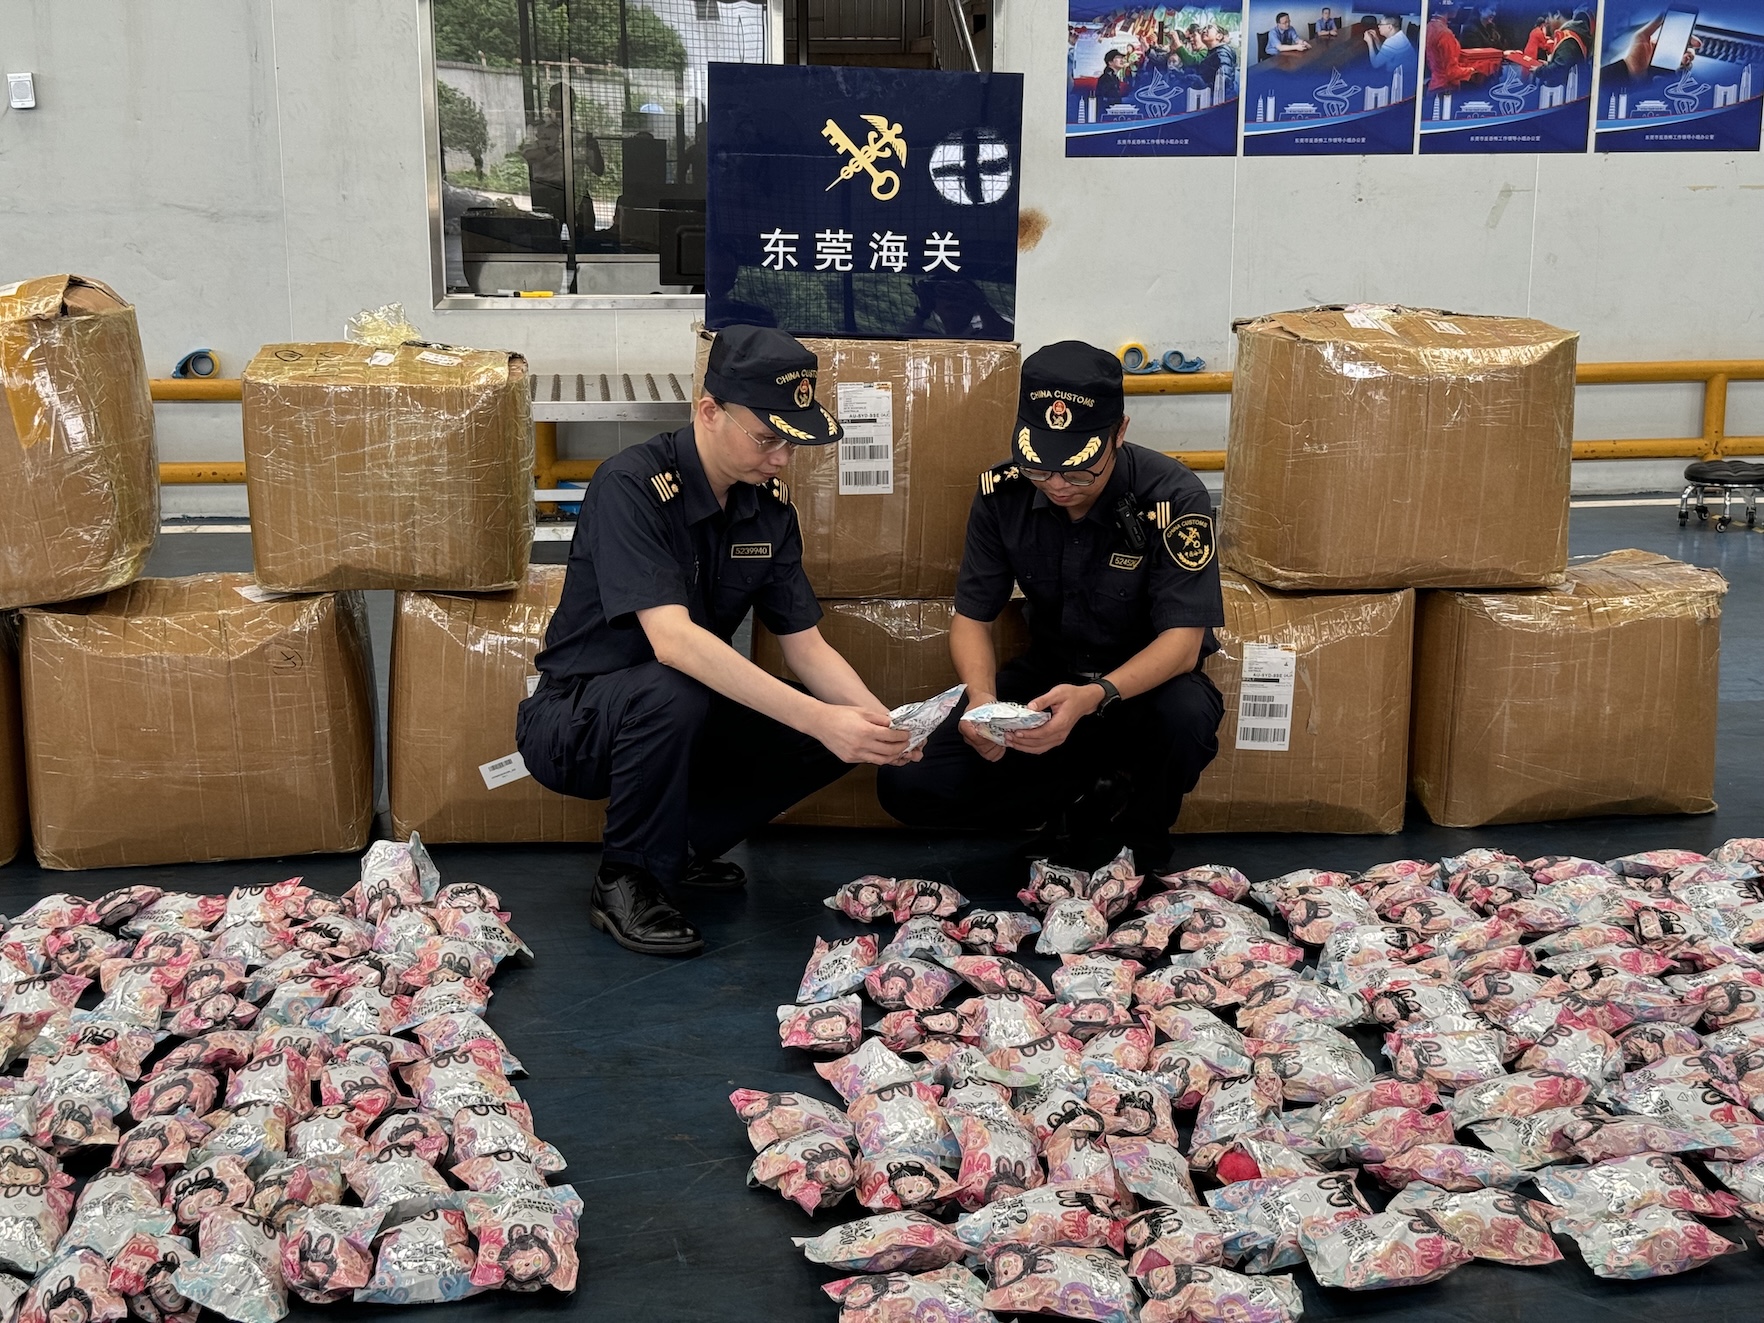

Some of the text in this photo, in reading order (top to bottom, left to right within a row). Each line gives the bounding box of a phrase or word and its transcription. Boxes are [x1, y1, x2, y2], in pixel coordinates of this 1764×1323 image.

[760, 228, 961, 273] 东莞海关
[775, 371, 801, 385] CHINA
[1030, 390, 1095, 408] CHINA CUSTOMS
[1181, 519, 1209, 528] CUSTOMS
